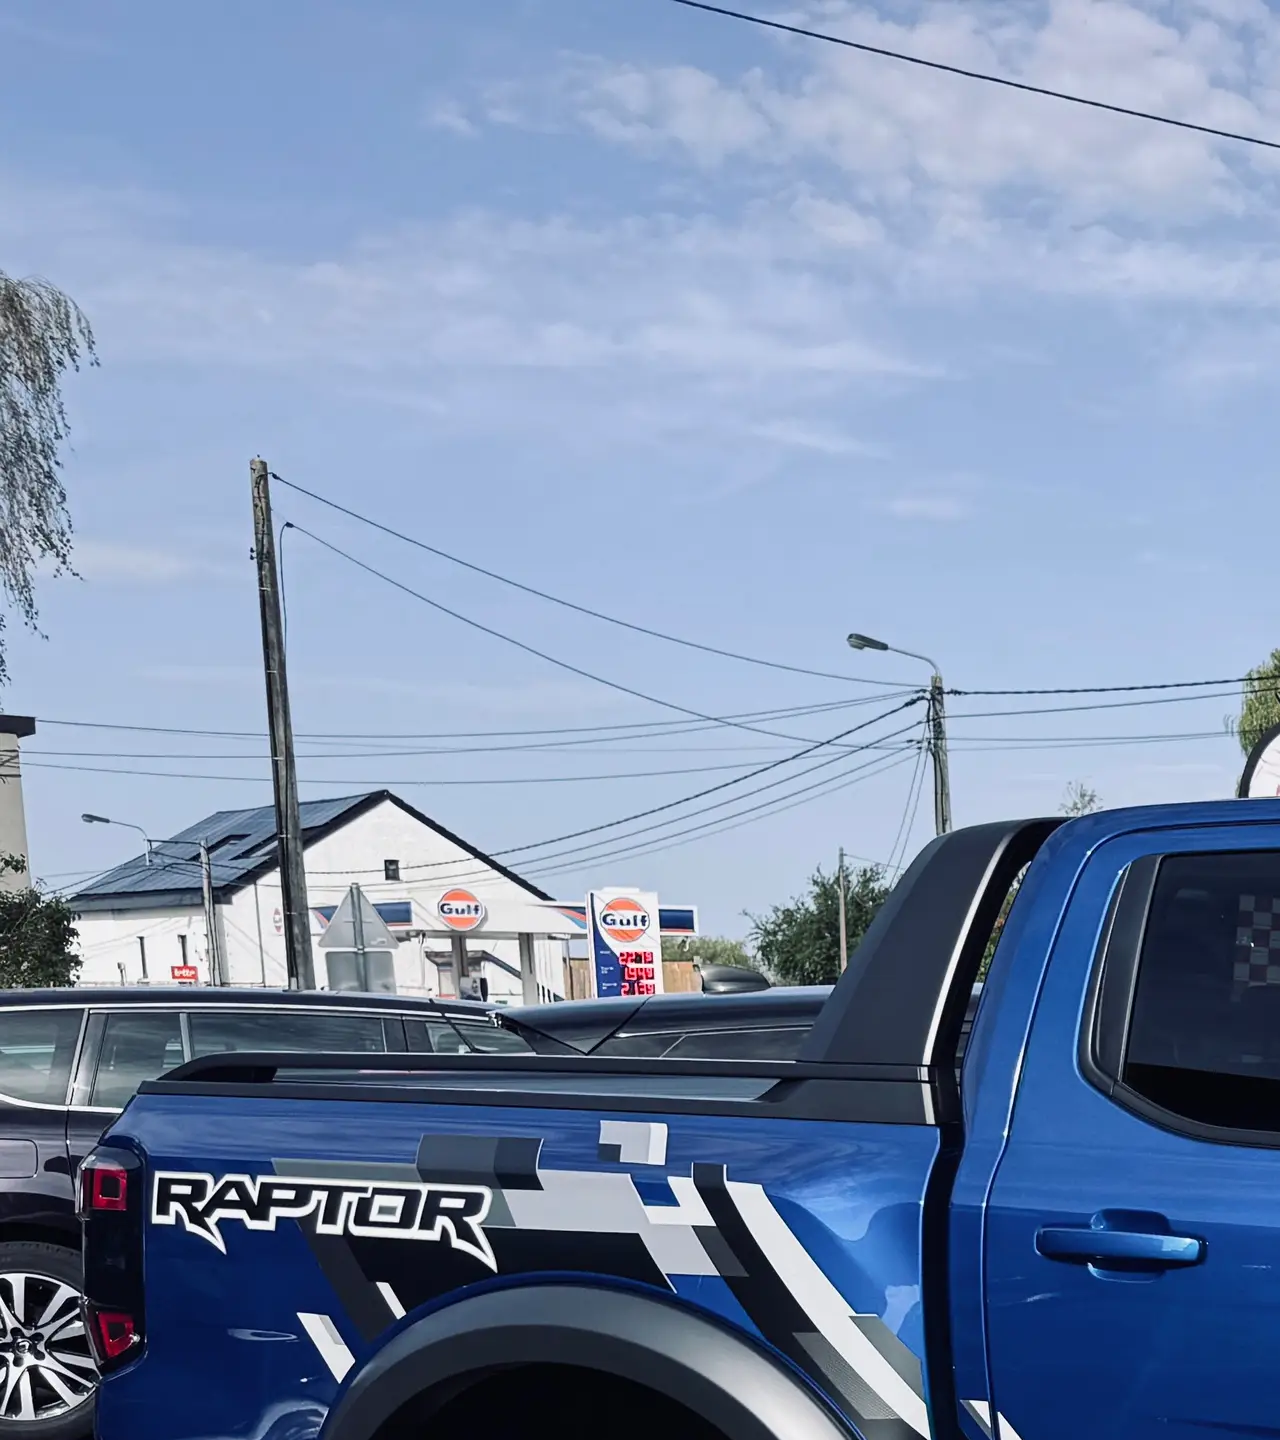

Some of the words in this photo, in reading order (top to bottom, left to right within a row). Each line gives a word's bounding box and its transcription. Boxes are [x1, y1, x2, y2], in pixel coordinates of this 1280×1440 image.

[440, 903, 479, 915] Gulf
[602, 913, 647, 926] Gulf
[151, 1170, 498, 1273] RAPTOR
